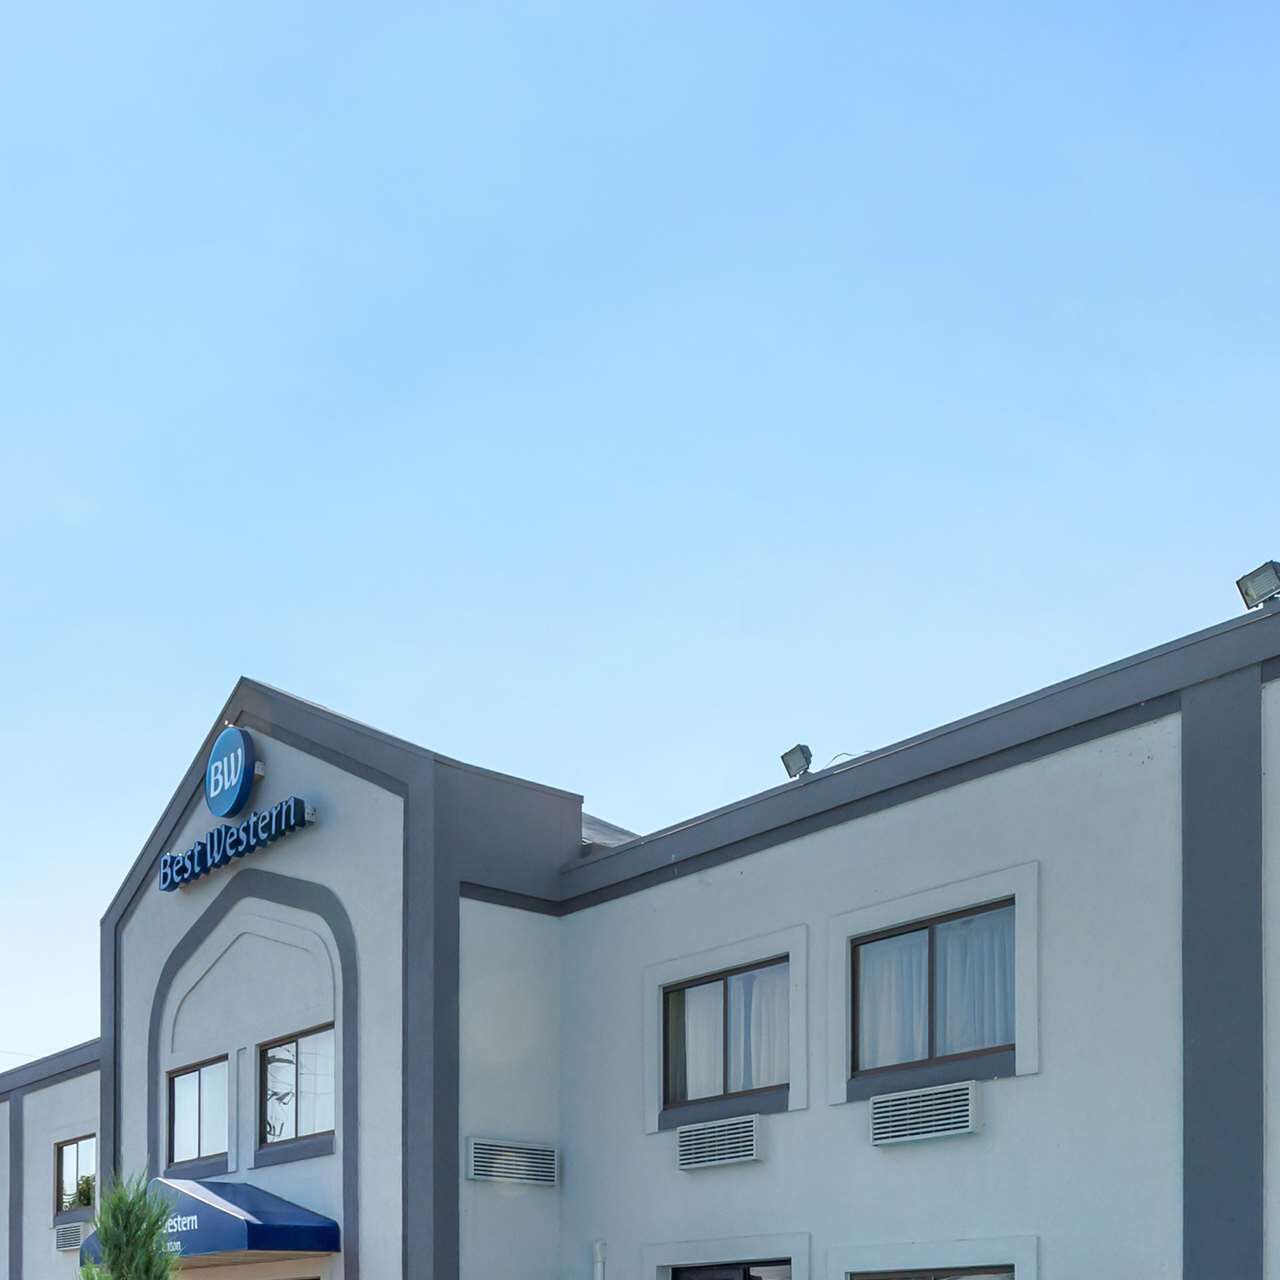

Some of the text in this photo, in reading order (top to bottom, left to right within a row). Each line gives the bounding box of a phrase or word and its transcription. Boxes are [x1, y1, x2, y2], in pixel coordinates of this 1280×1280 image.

[210, 749, 242, 798] BW
[159, 797, 298, 891] Best Western
